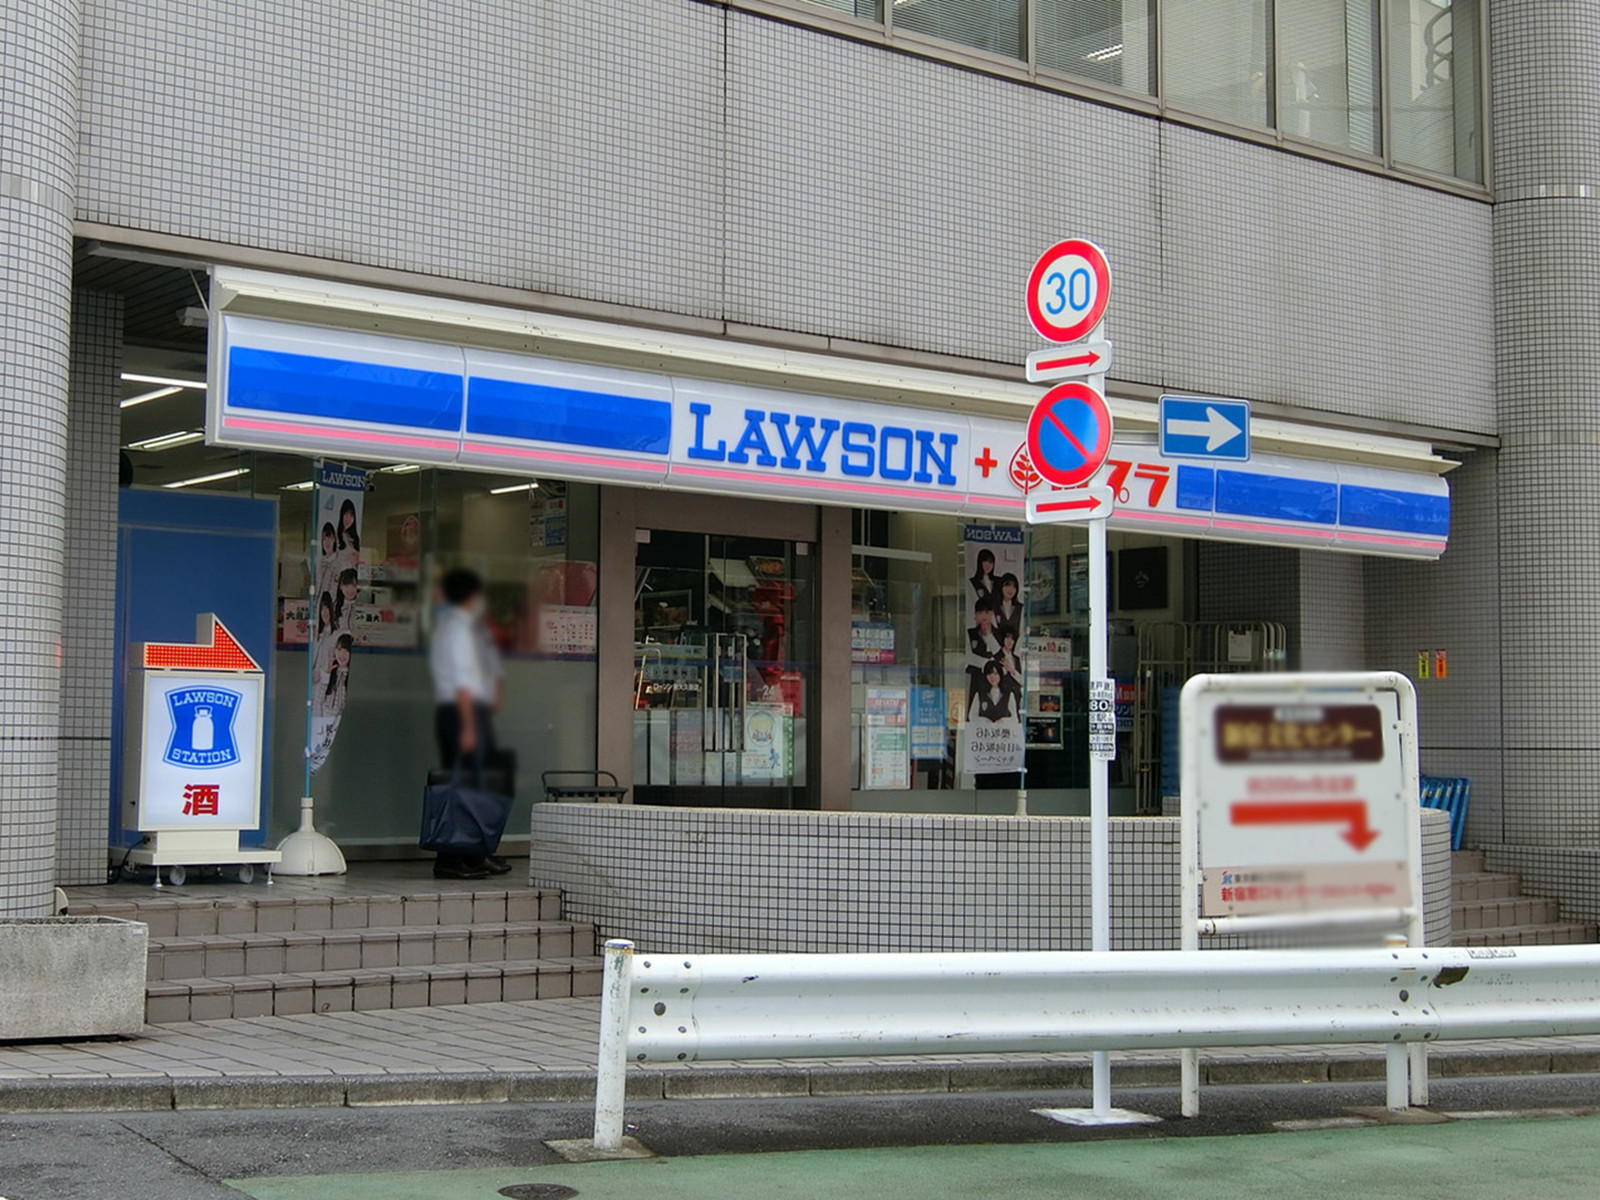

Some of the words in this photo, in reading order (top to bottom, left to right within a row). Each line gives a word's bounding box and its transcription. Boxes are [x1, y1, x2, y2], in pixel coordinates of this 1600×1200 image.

[1045, 267, 1091, 315] 30
[687, 402, 958, 486] LAWSON
[322, 470, 365, 488] LAWSON
[172, 691, 235, 708] LAWSON
[171, 748, 232, 763] STATION
[182, 783, 220, 816] 酒
